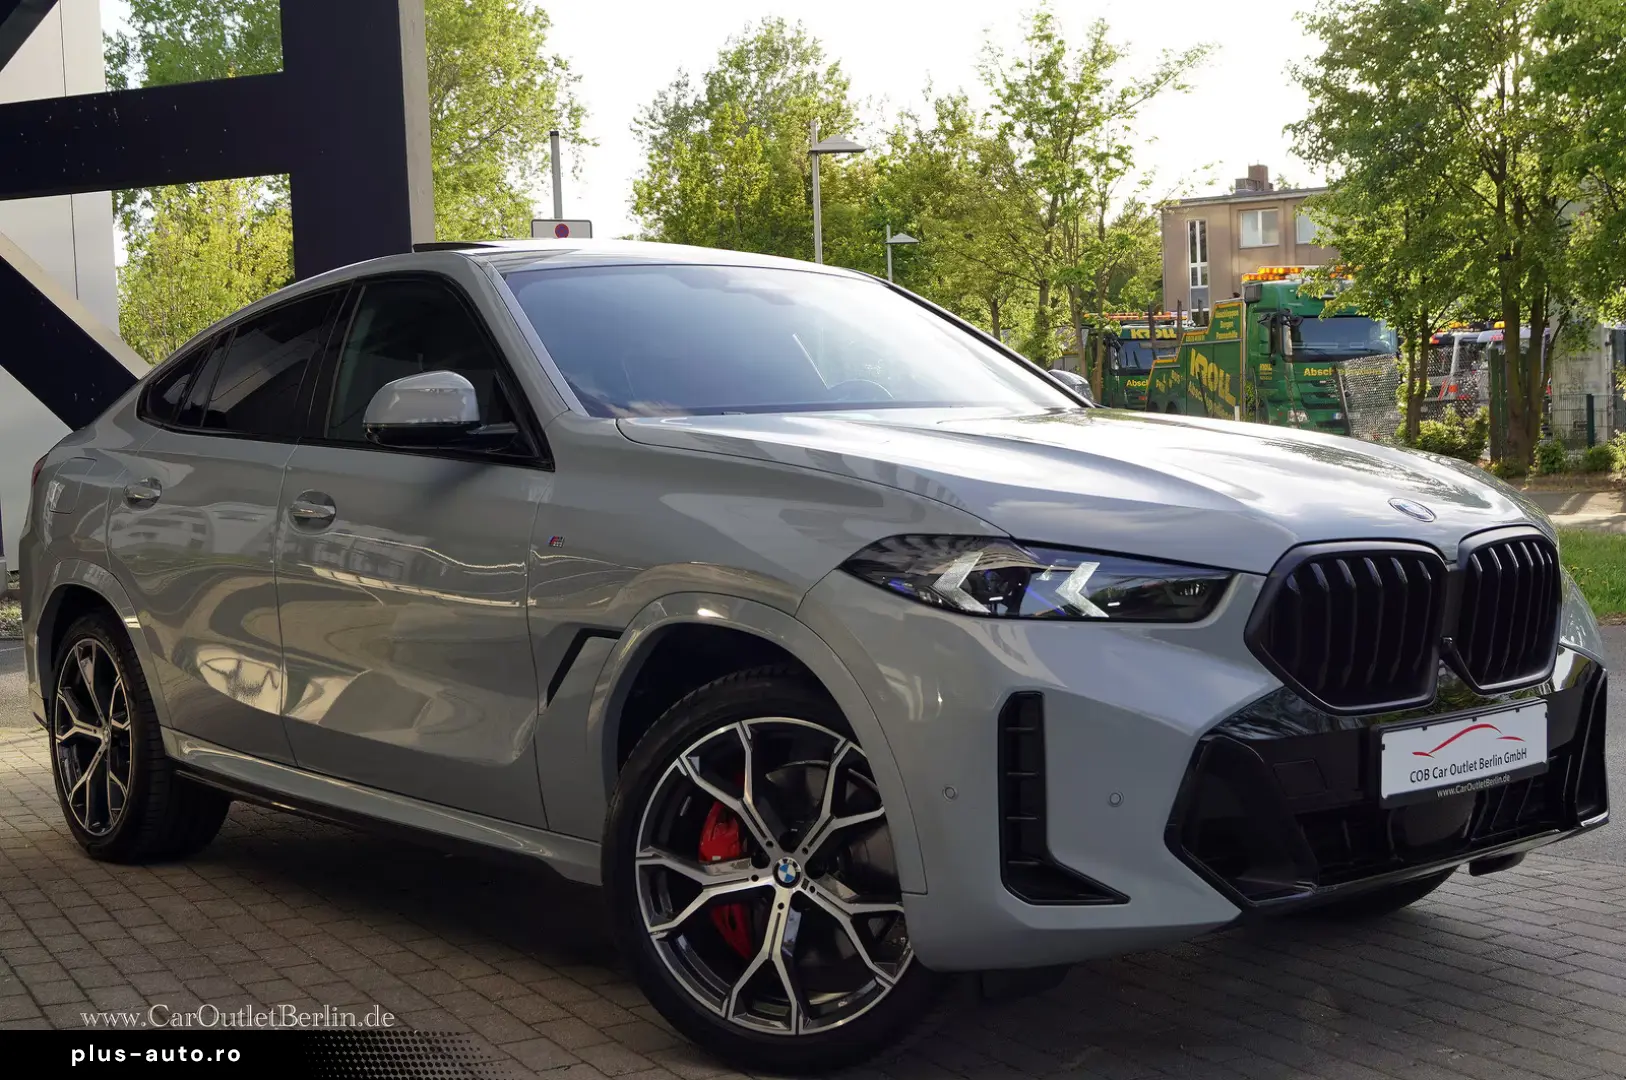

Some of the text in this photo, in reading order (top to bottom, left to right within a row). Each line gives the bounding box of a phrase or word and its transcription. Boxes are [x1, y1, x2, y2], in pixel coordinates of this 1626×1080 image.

[1410, 748, 1528, 783] COB Car Outlet Berlin GmbH
[1436, 774, 1511, 798] www.CarOutletBerlin.de
